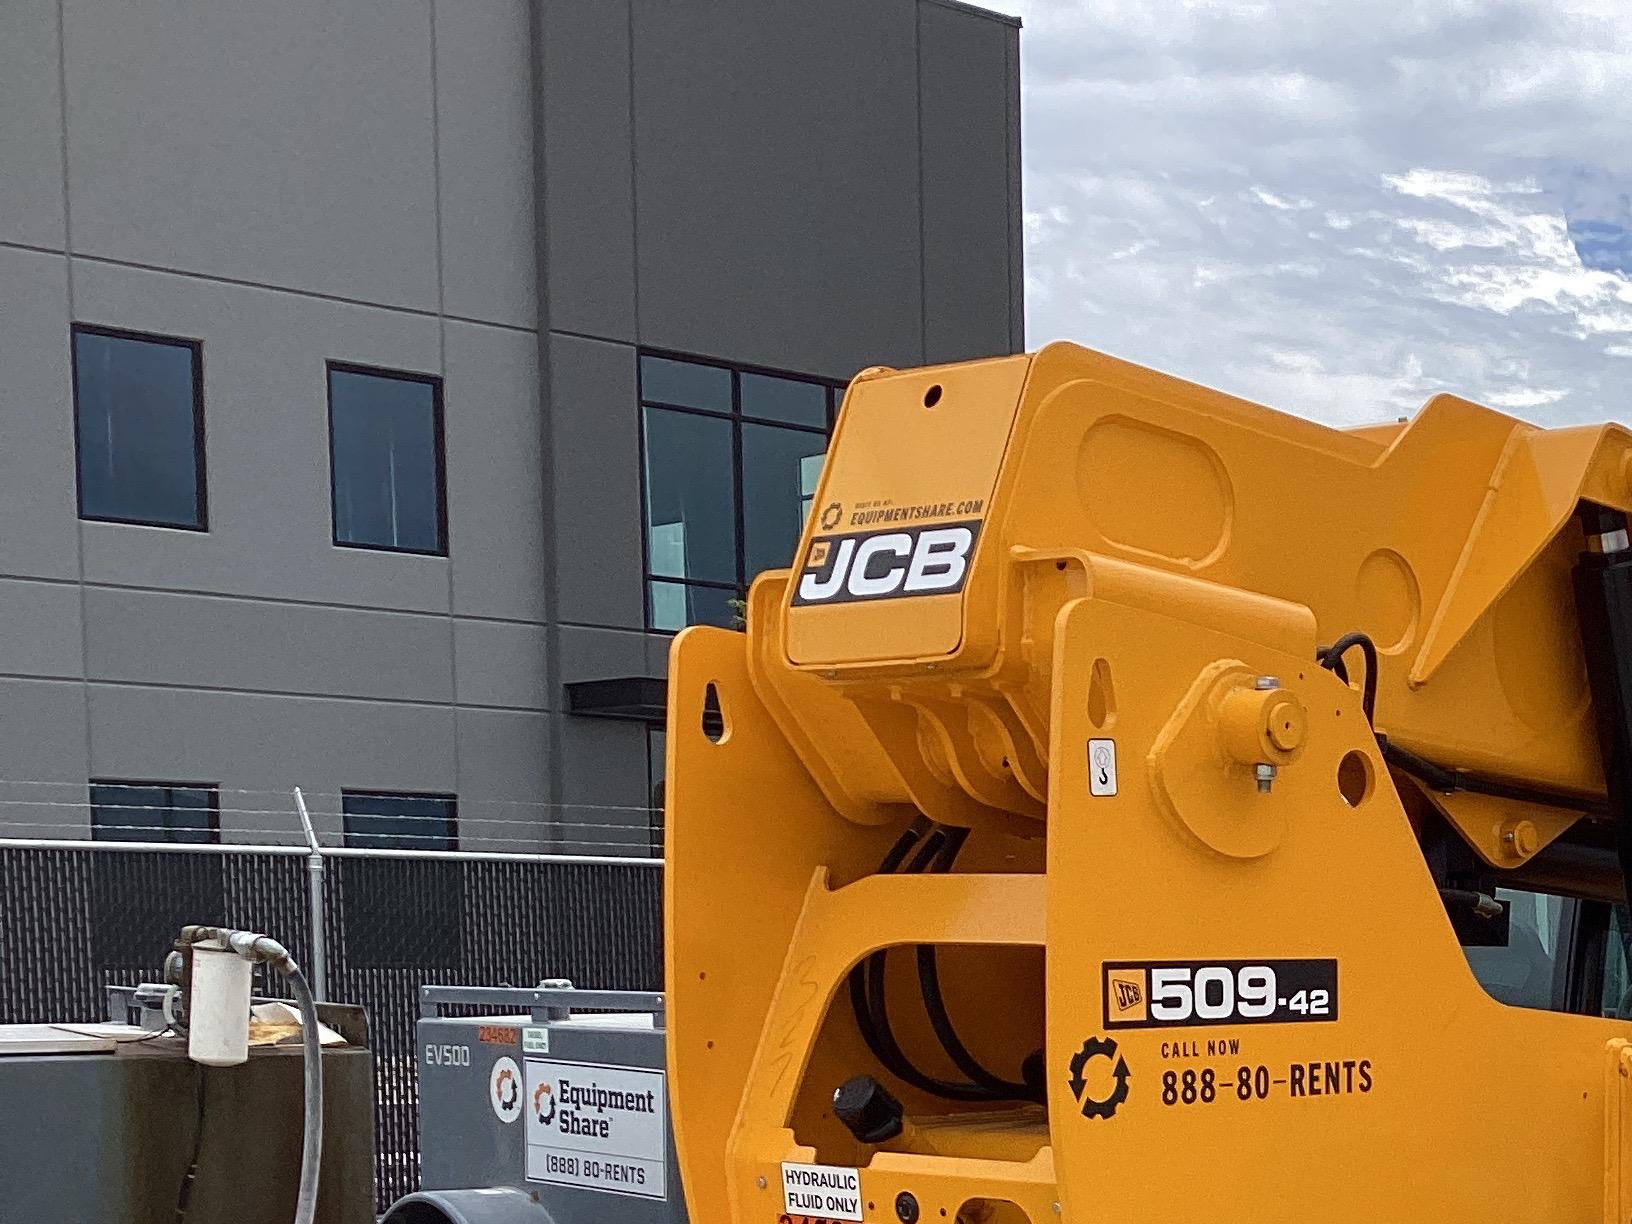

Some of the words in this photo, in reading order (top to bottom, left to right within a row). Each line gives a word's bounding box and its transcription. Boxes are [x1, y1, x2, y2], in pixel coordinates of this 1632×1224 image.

[850, 499, 984, 526] EQUIPMENTSHARE.COM
[799, 527, 972, 600] JCB
[1117, 981, 1141, 1009] JCB
[1151, 966, 1330, 1021] 509-42
[425, 1044, 471, 1068] EV500
[1161, 1042, 1200, 1059] CALL
[1207, 1038, 1241, 1057] NOW
[559, 1079, 655, 1114] Equipment
[1161, 1059, 1373, 1107] 888-80-RENTS
[559, 1109, 610, 1138] Share
[546, 1153, 580, 1177] (888)
[584, 1156, 646, 1185] 80-RENTS
[785, 1169, 857, 1191] HYDRAULIC
[788, 1192, 824, 1211] FLUID
[826, 1195, 858, 1214] ONLY
